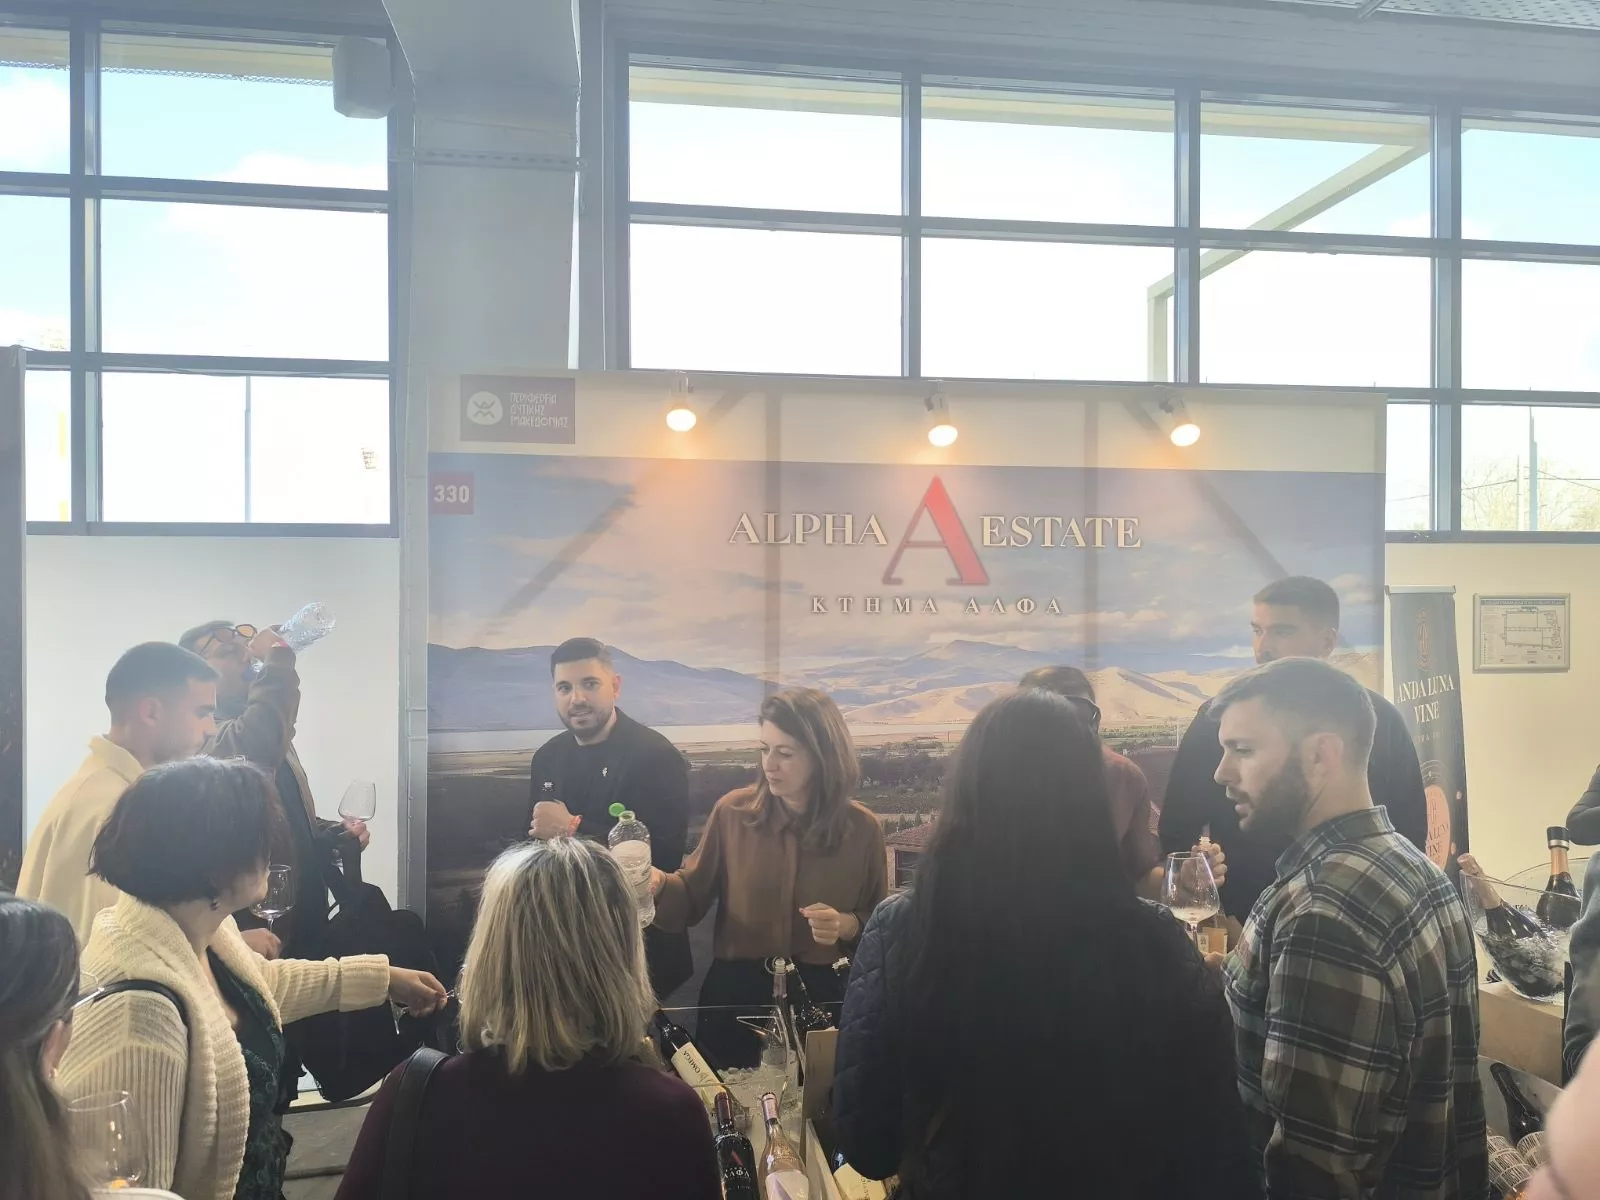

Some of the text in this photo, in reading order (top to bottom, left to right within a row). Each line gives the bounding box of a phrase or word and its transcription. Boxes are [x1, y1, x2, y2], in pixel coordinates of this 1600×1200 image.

[434, 484, 470, 504] 330
[728, 474, 1142, 587] ALPHA A ESTATE
[811, 596, 1062, 616] ΚΤΗΜΑ ΑΛΦΑ
